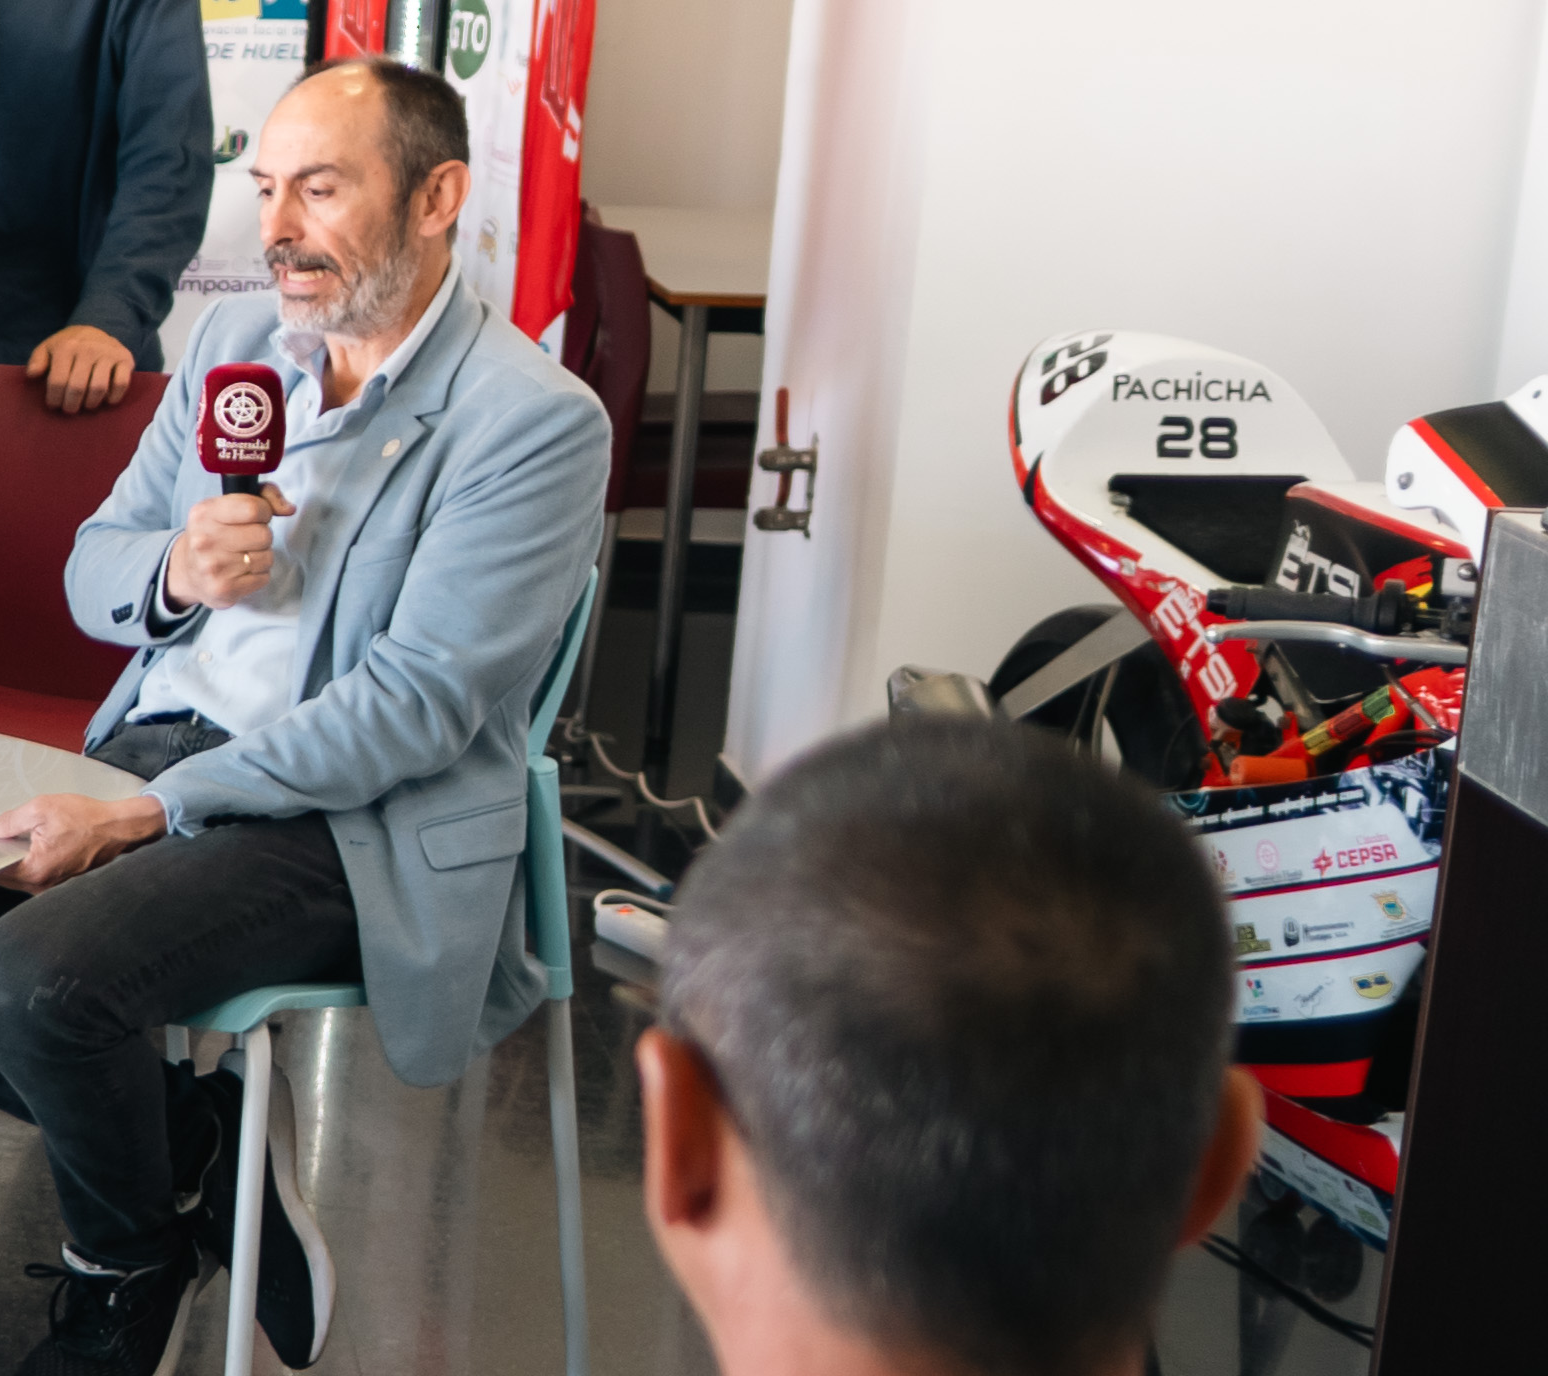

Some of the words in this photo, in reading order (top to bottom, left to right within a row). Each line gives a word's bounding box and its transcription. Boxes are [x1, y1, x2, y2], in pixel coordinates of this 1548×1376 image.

[205, 42, 235, 59] DE
[215, 437, 270, 450] Universidad
[1156, 415, 1238, 459] 28
[218, 448, 231, 460] de
[1337, 843, 1399, 869] CEPSA
